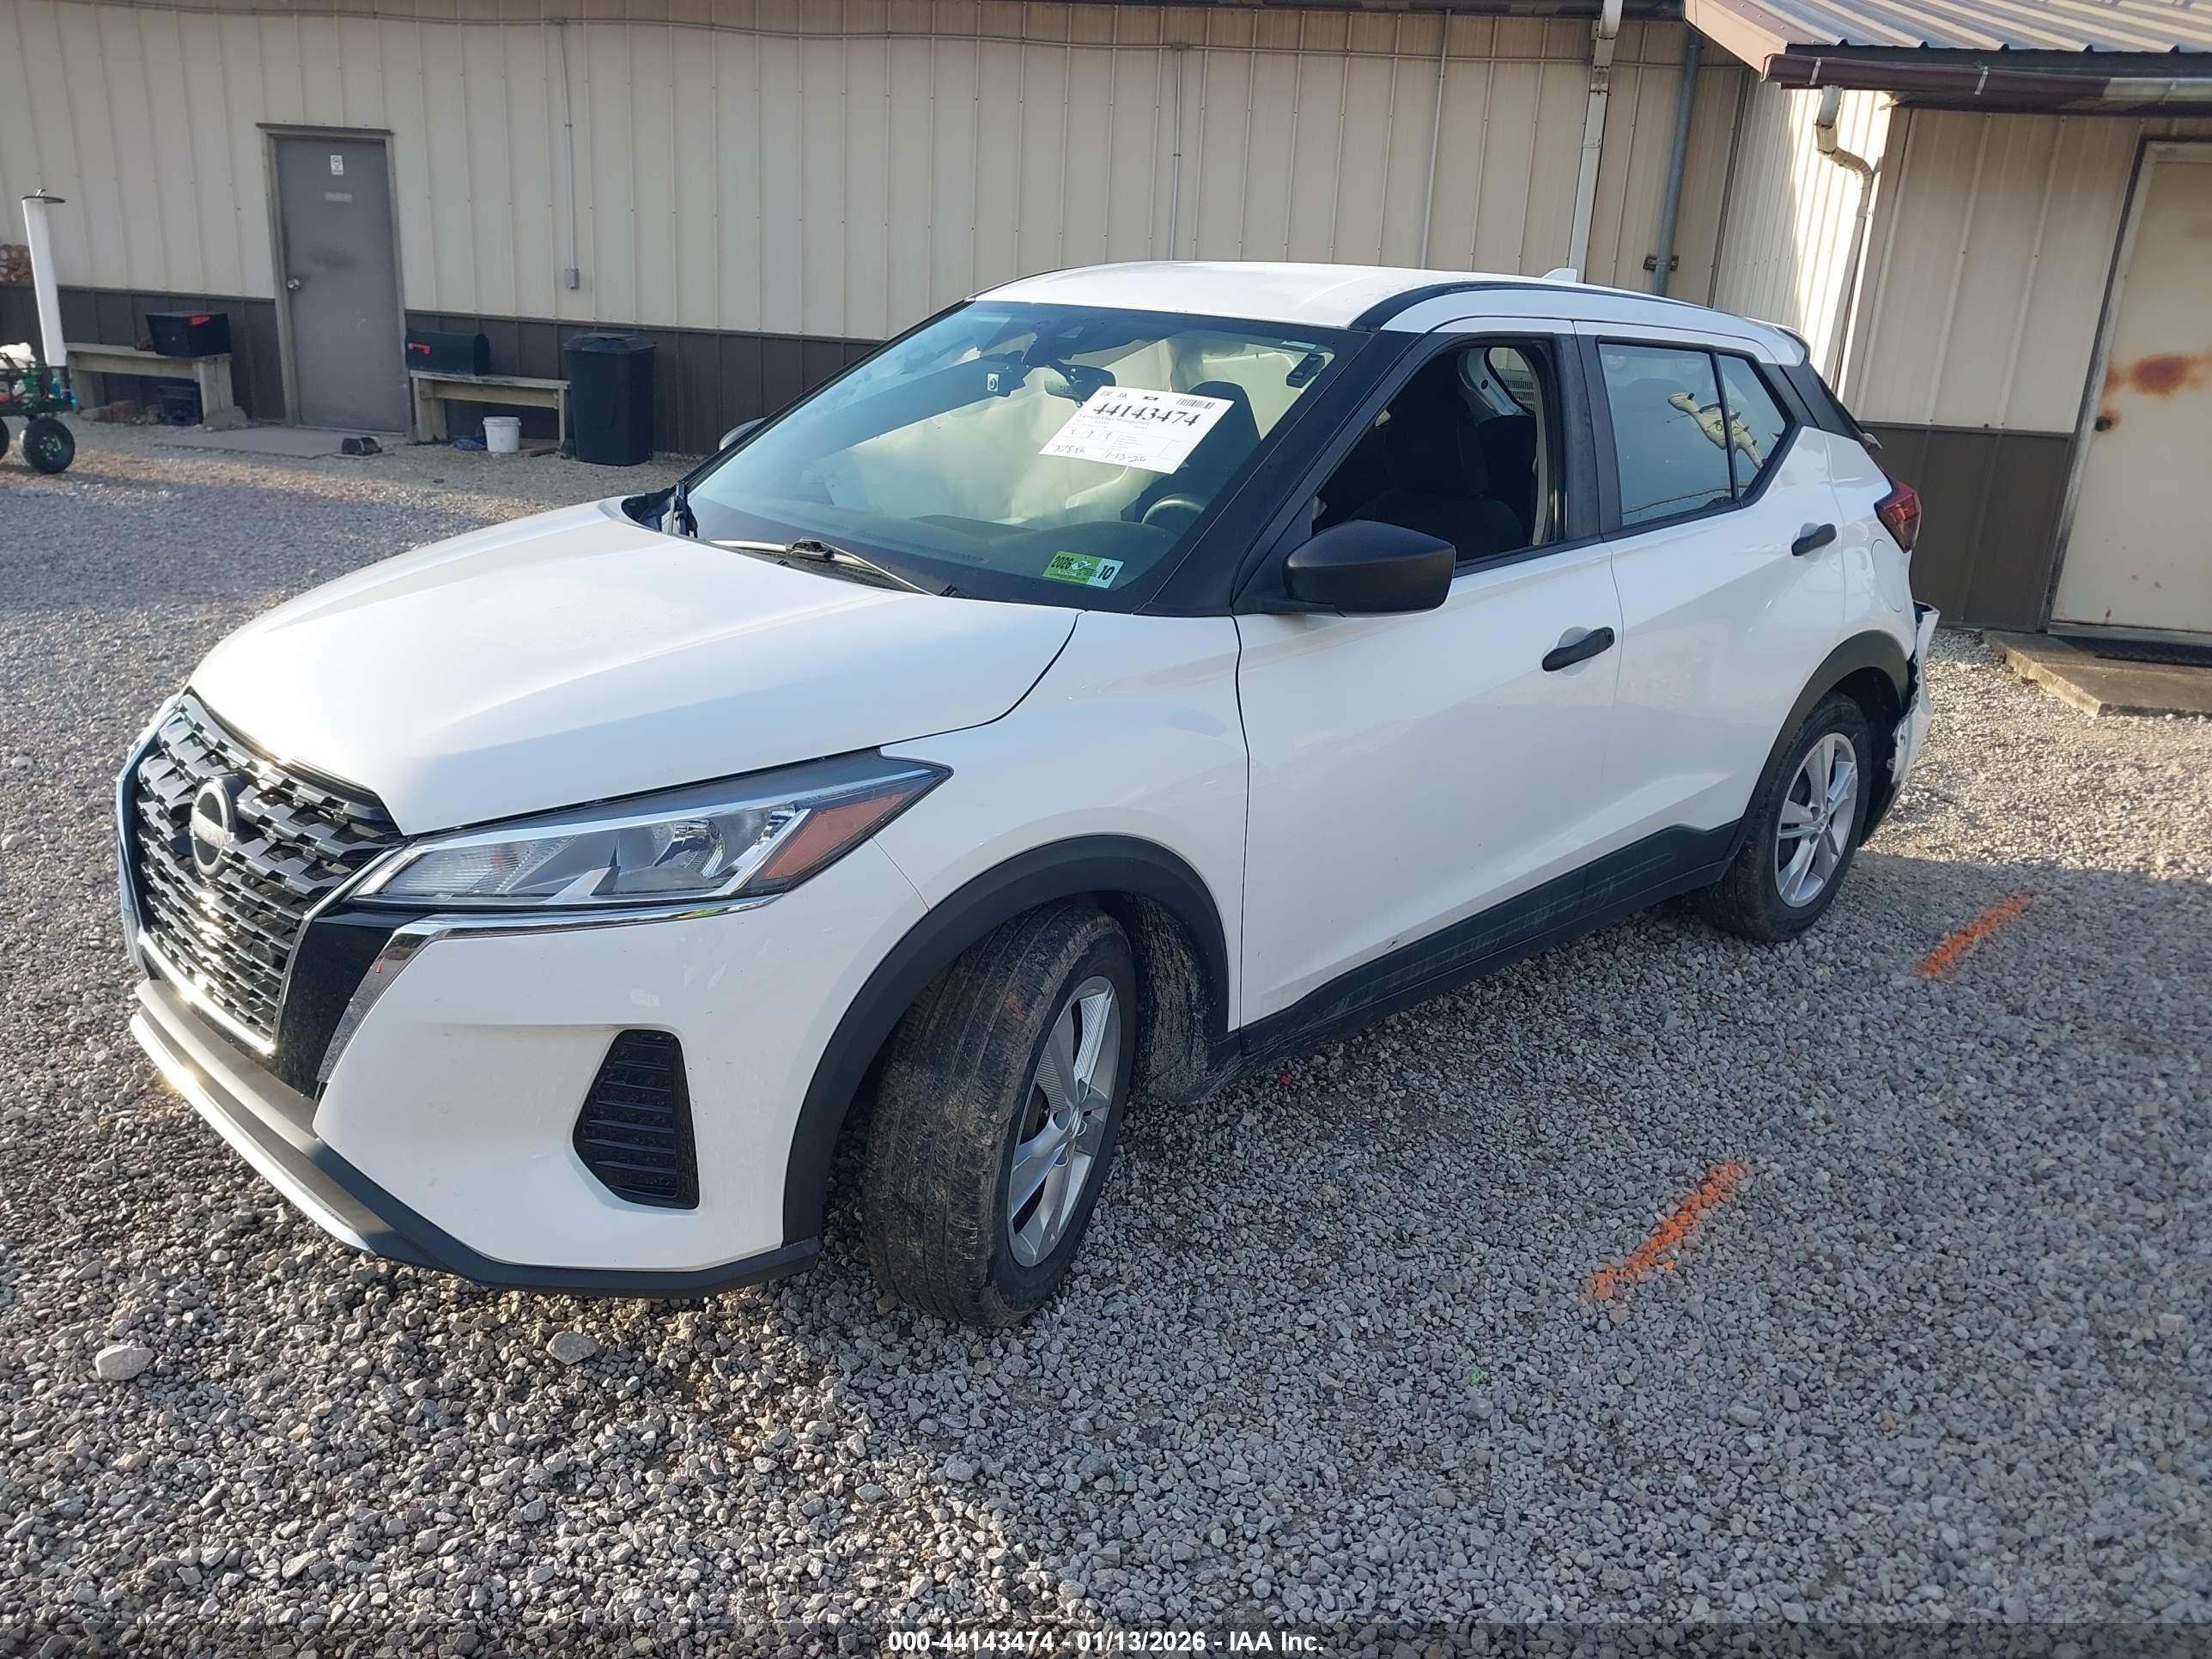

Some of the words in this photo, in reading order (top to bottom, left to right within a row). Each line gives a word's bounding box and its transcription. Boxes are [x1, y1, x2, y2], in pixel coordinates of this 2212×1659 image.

[1093, 402, 1201, 427] 44143474
[1050, 556, 1074, 570] 2026
[1097, 564, 1115, 581] 10
